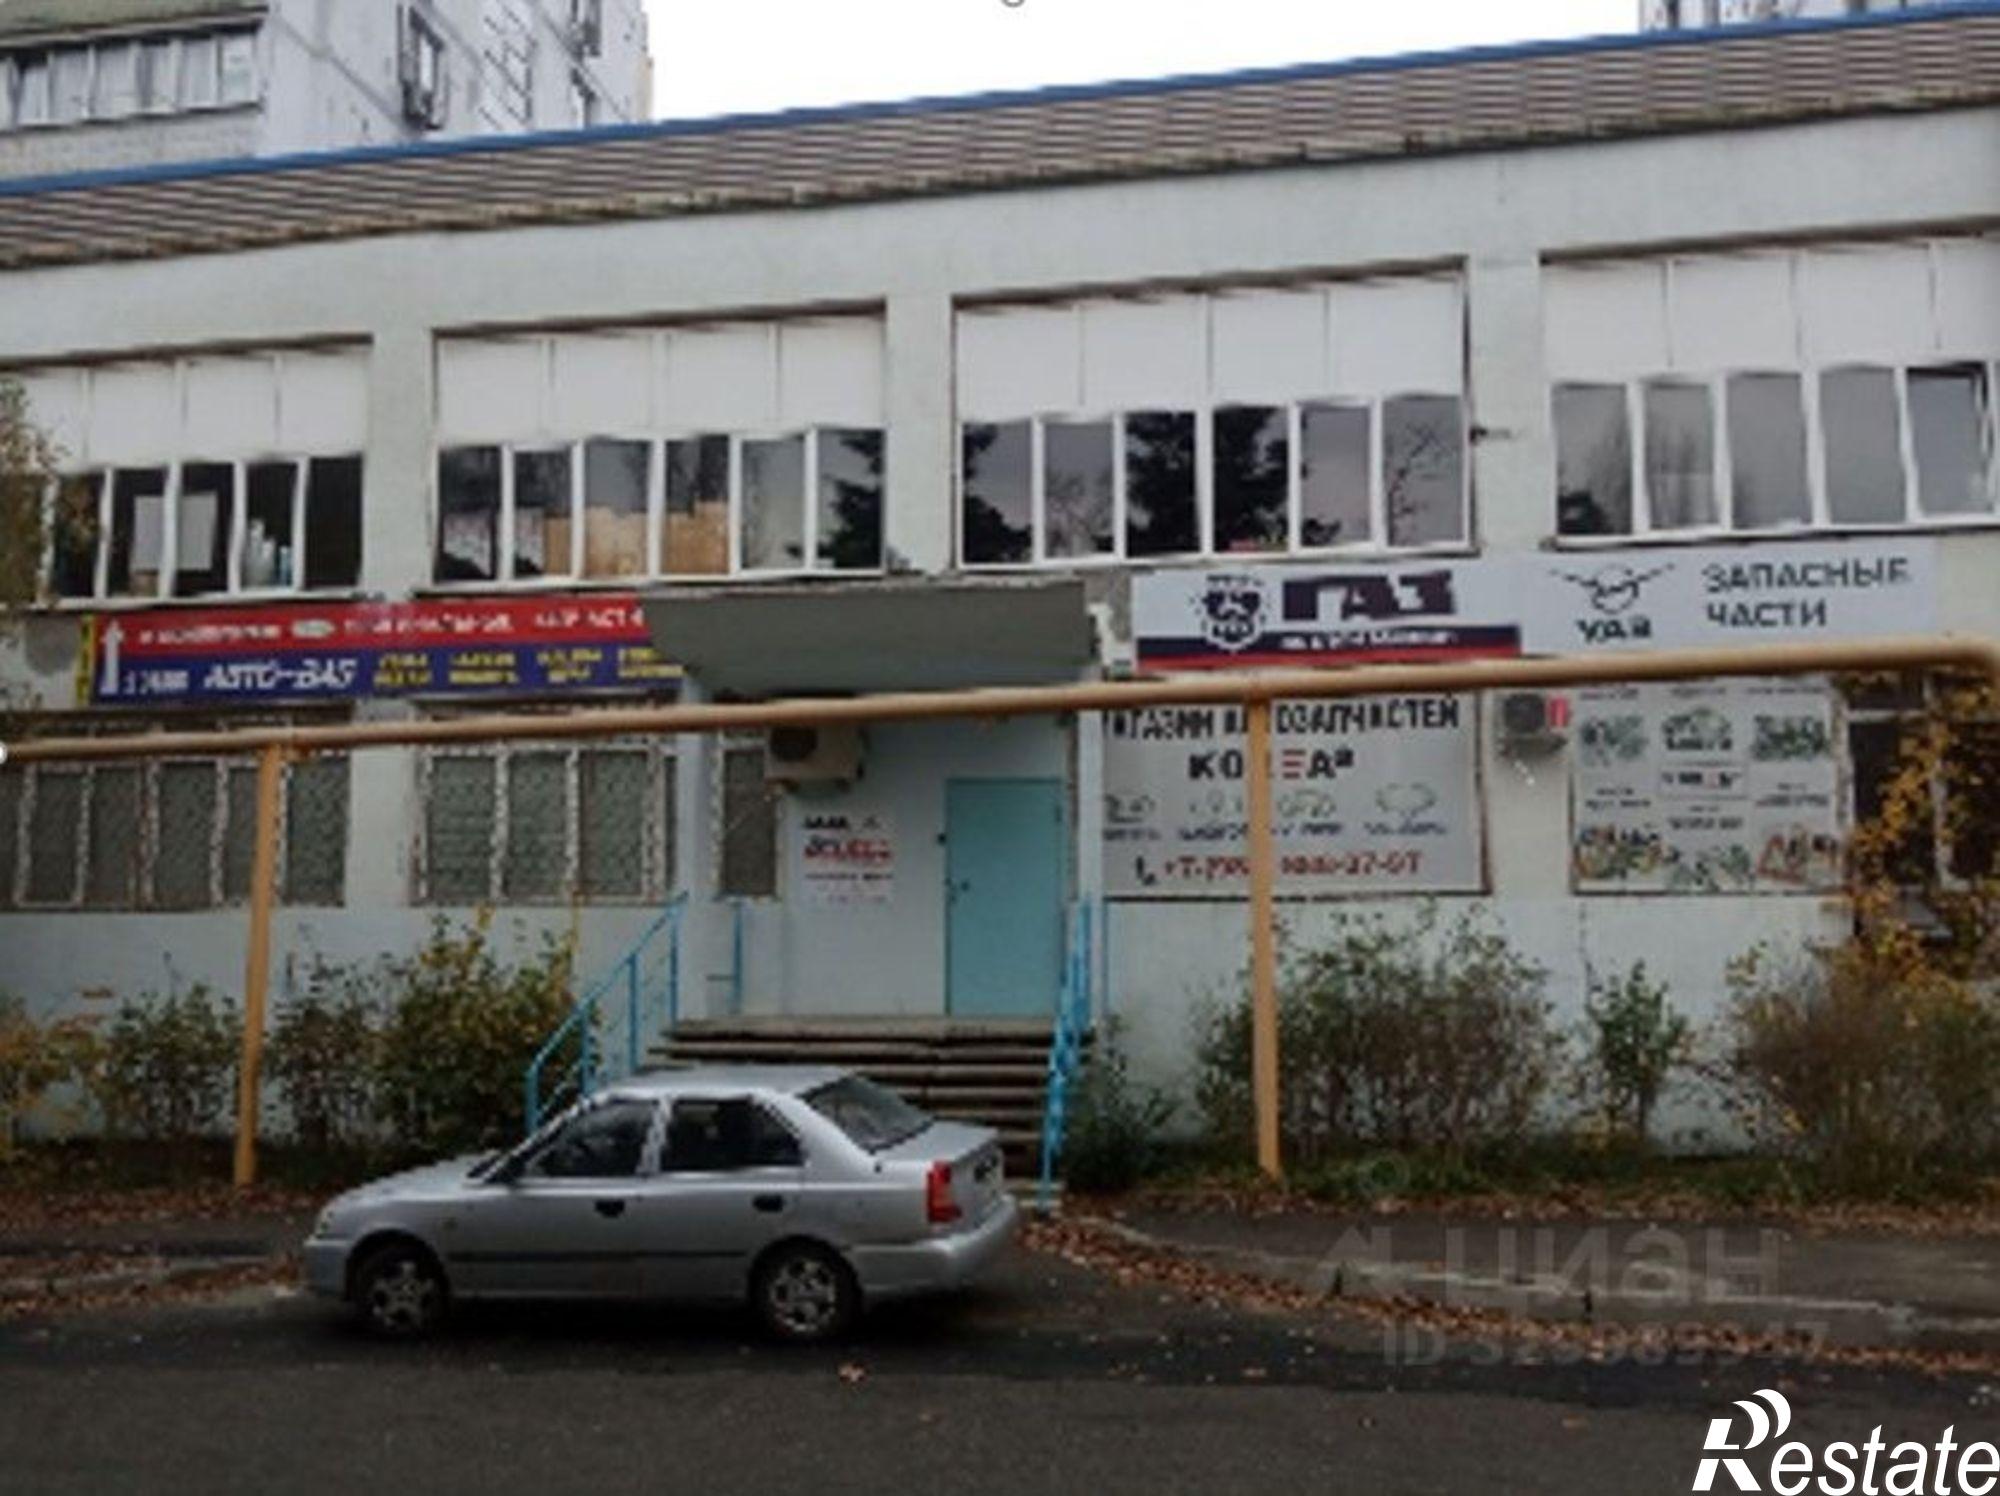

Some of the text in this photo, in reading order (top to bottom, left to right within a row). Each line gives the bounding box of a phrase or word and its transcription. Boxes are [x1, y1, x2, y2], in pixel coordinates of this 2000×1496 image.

[1704, 558, 1908, 592] ЗАПАСНЫЕ
[1282, 570, 1453, 621] ГАЗ
[1706, 600, 1827, 627] ЧАСТИ
